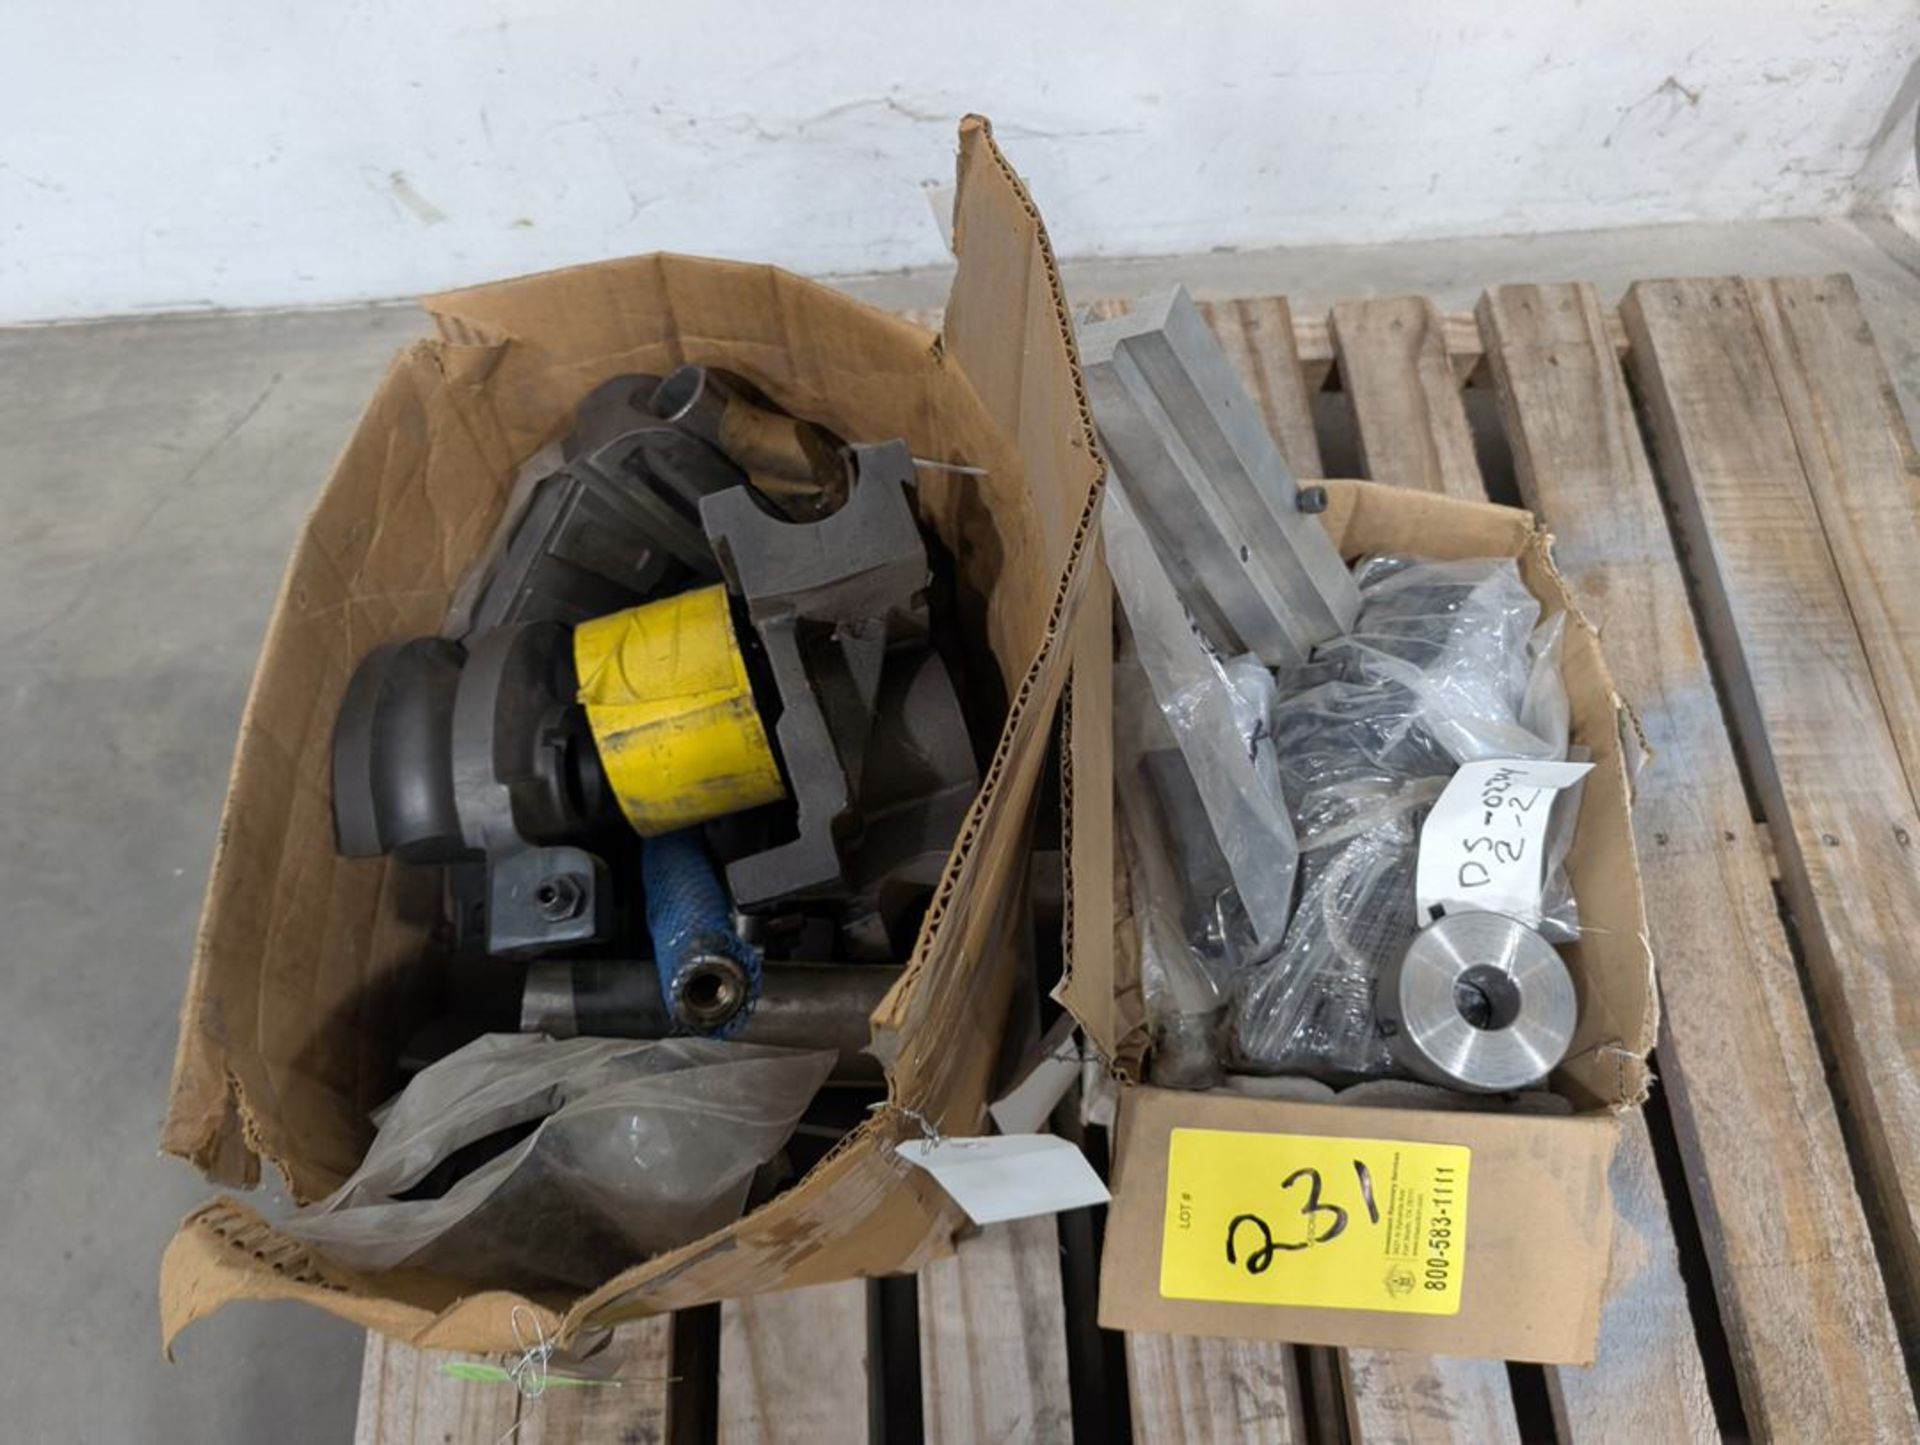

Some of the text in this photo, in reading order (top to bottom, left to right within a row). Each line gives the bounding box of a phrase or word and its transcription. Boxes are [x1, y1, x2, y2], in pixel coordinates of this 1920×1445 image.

[1178, 1203, 1190, 1229] LOT
[1227, 1160, 1380, 1275] 231
[1424, 1168, 1455, 1292] 800-583-1111
